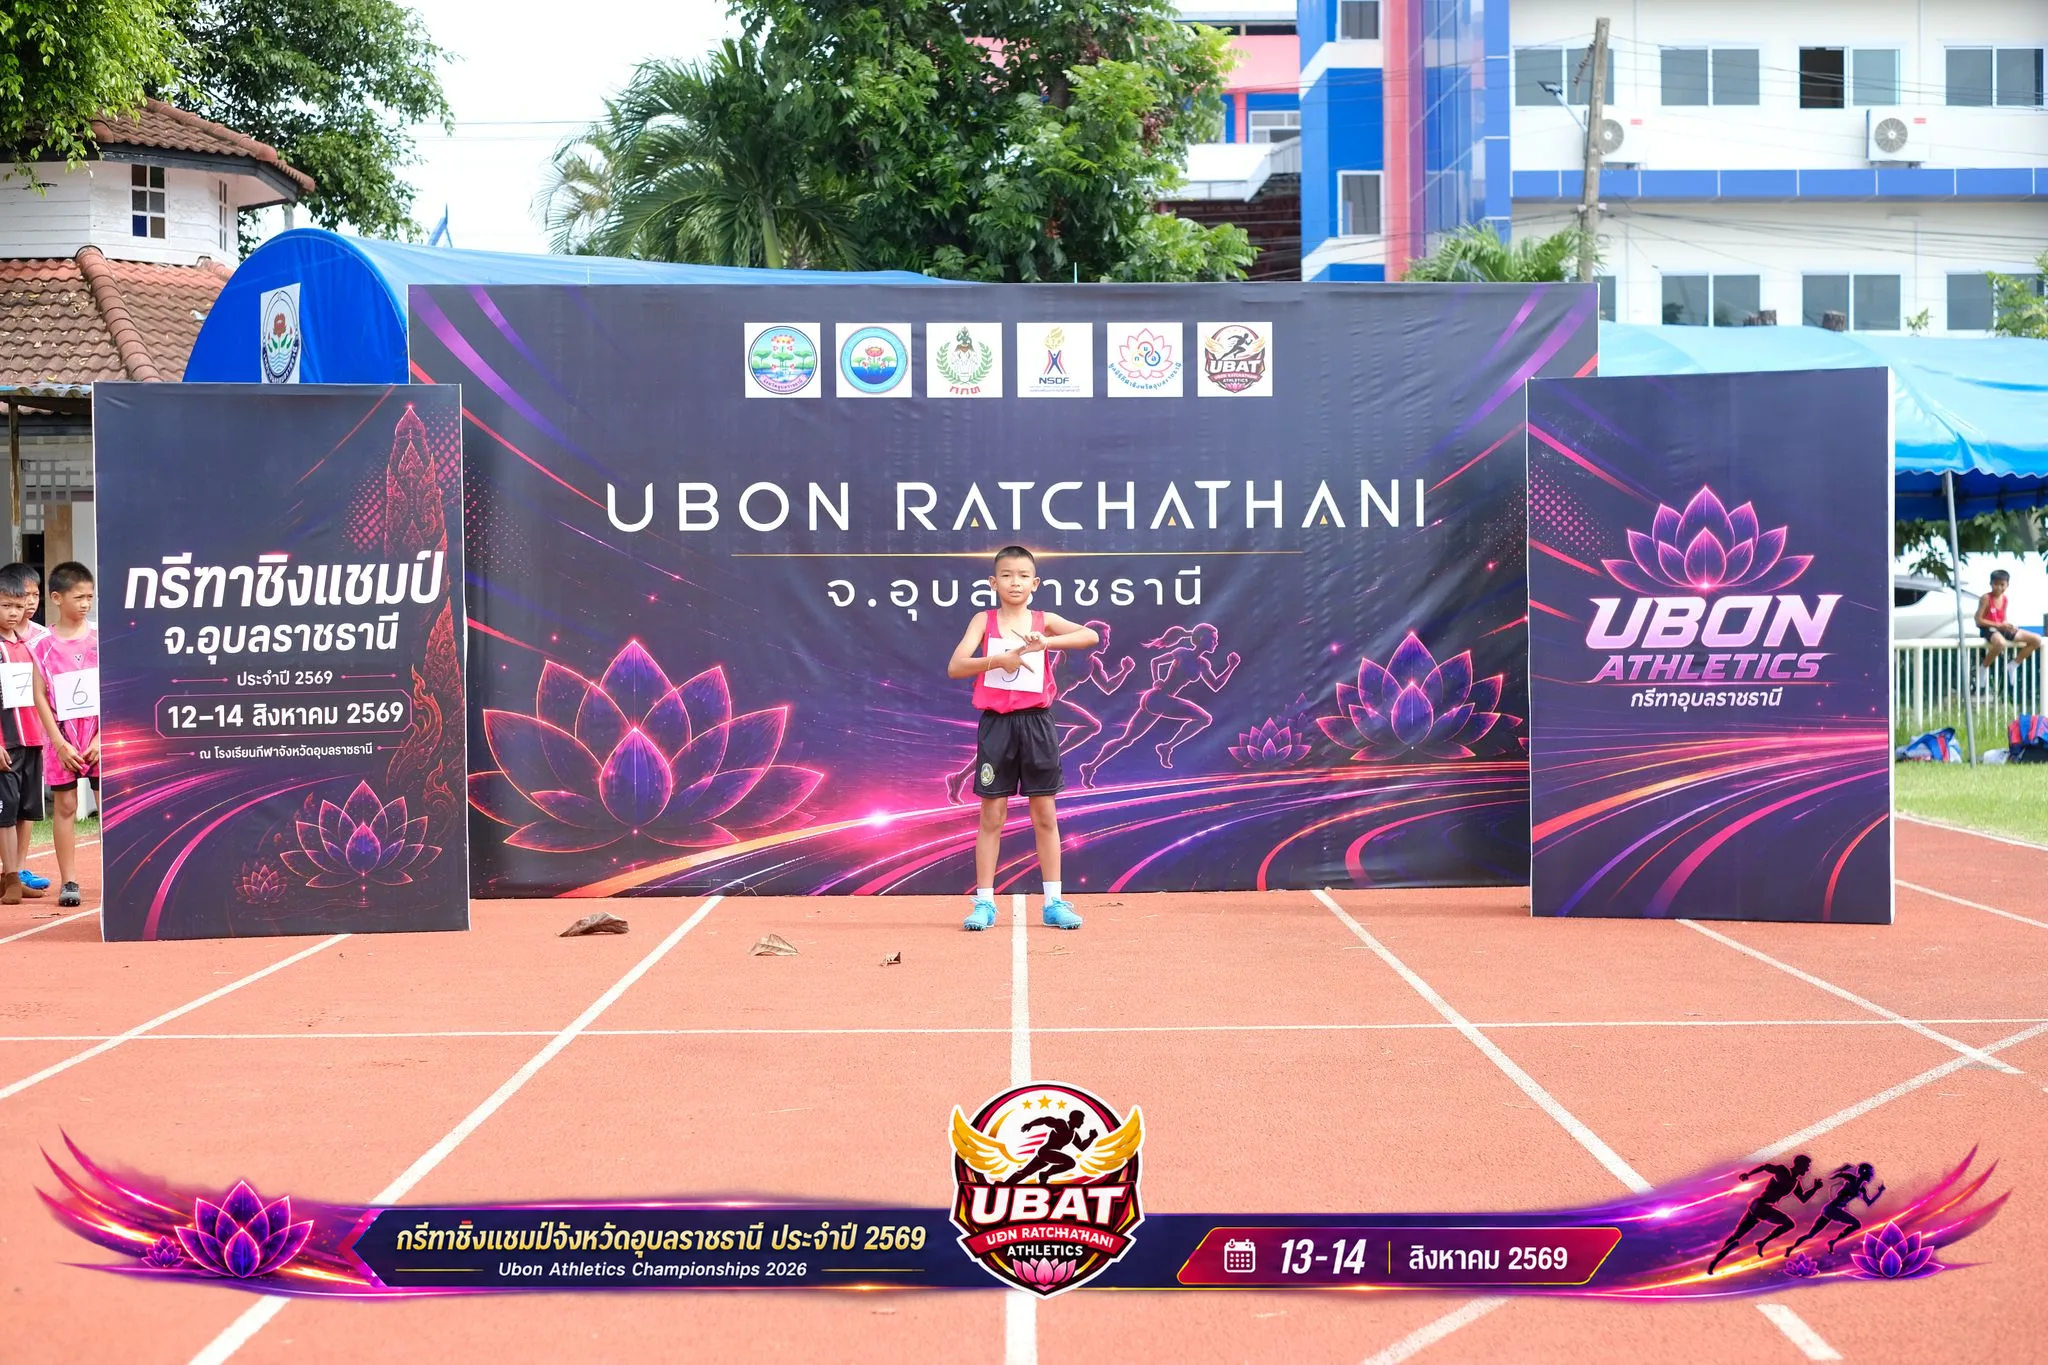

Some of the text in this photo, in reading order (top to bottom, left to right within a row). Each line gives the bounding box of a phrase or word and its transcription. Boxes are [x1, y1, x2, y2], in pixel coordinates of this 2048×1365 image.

[1039, 376, 1070, 385] NSDF
[1209, 360, 1262, 374] UBAT
[607, 479, 1425, 533] UBON RATCHATHANI
[125, 550, 445, 609] กรีฑาชิงแชมป์
[827, 565, 1201, 622] จ.อุบลาชธานี
[1585, 594, 1844, 650] UBON
[164, 612, 400, 665] จ.อุบลราชธานี
[237, 669, 333, 687] ประจำปี 2569
[1586, 652, 1837, 682] ATHLETICS
[12, 672, 32, 697] 7
[72, 678, 88, 706] 6
[1630, 687, 1784, 713] กรีฑาอุบลราชธานี
[252, 703, 338, 727] สิงหาคม
[346, 702, 404, 724] 2569
[199, 742, 373, 760] ณ โรงเรียนกีฬาจังหวัดอุบลราชธานี
